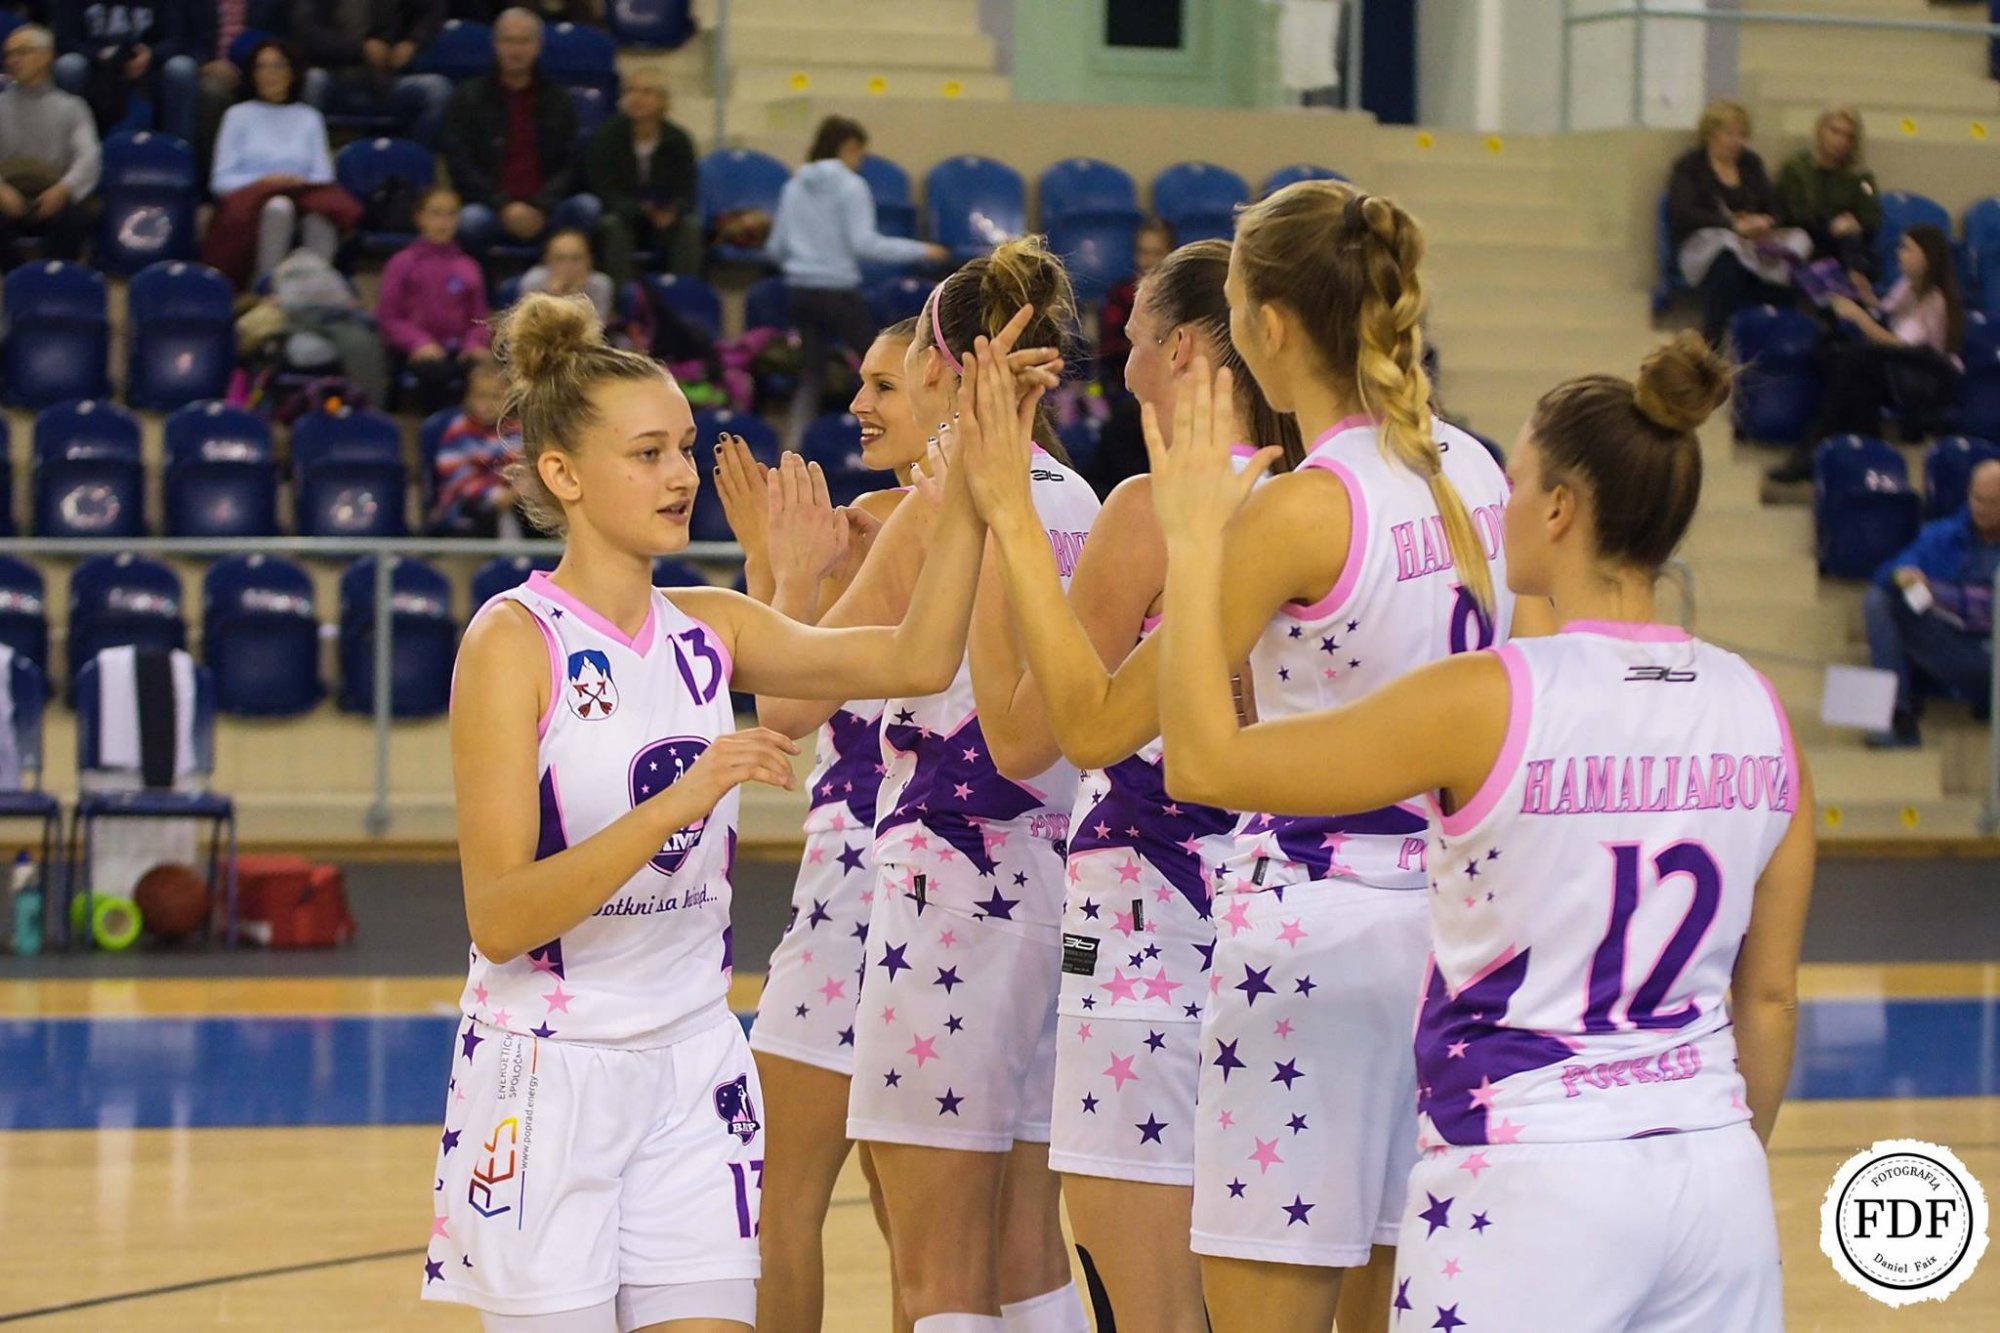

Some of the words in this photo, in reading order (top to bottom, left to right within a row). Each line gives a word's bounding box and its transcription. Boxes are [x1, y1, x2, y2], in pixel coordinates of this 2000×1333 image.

[667, 627, 723, 706] 13
[592, 895, 654, 916] otkni
[1581, 838, 1722, 1035] 12
[468, 1115, 518, 1219] PES
[520, 1075, 539, 1170] www.poprad.energy
